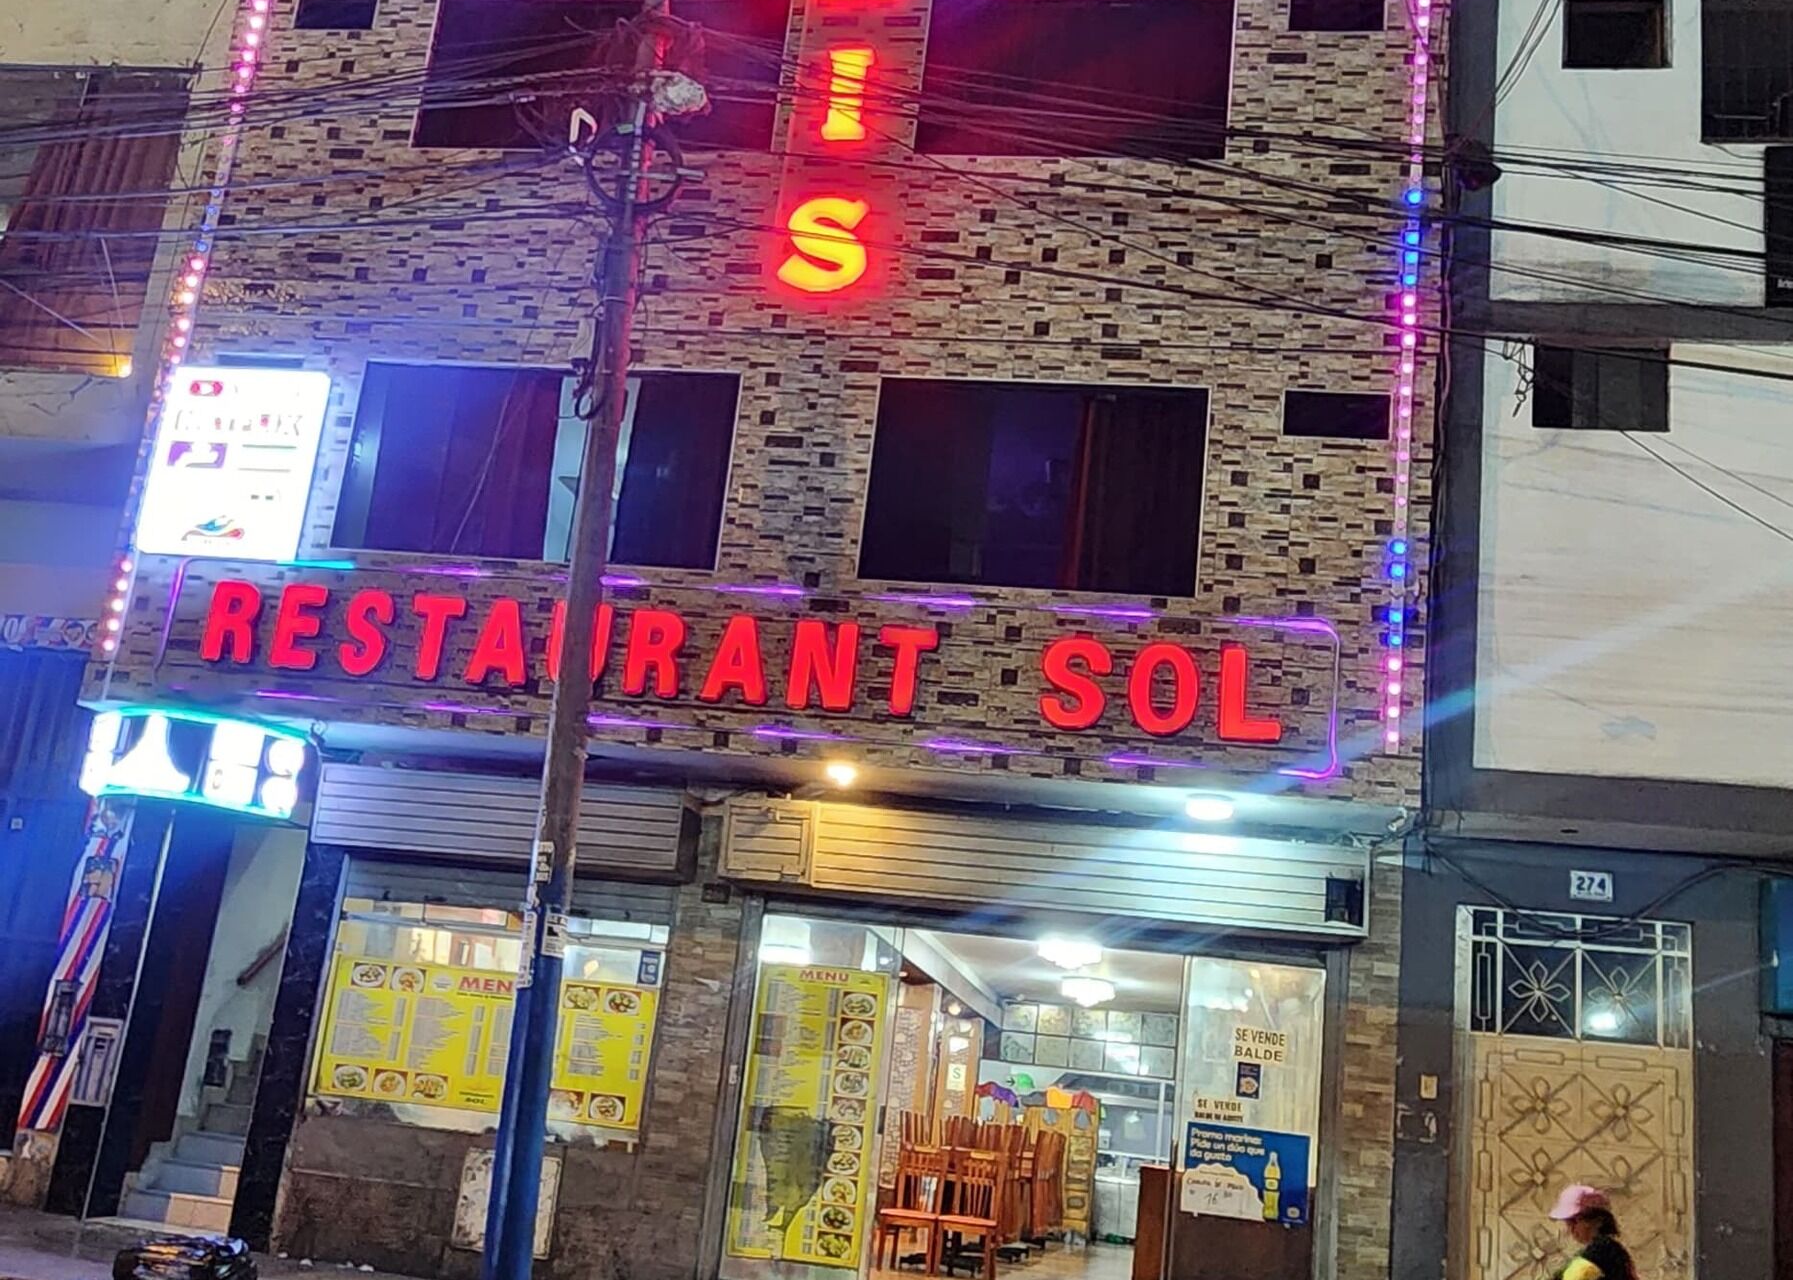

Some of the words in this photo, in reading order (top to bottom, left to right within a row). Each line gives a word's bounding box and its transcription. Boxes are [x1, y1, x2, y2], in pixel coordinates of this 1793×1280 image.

[201, 579, 940, 717] RESTAURANT
[1039, 635, 1284, 743] SOL
[1576, 876, 1606, 892] 274
[800, 969, 849, 981] MENU
[459, 976, 513, 993] MEN
[1235, 1027, 1249, 1042] SE
[1251, 1029, 1286, 1047] VENDE
[1234, 1045, 1284, 1062] BALDE
[1214, 1100, 1242, 1112] VENDE
[1191, 1126, 1223, 1141] Promo
